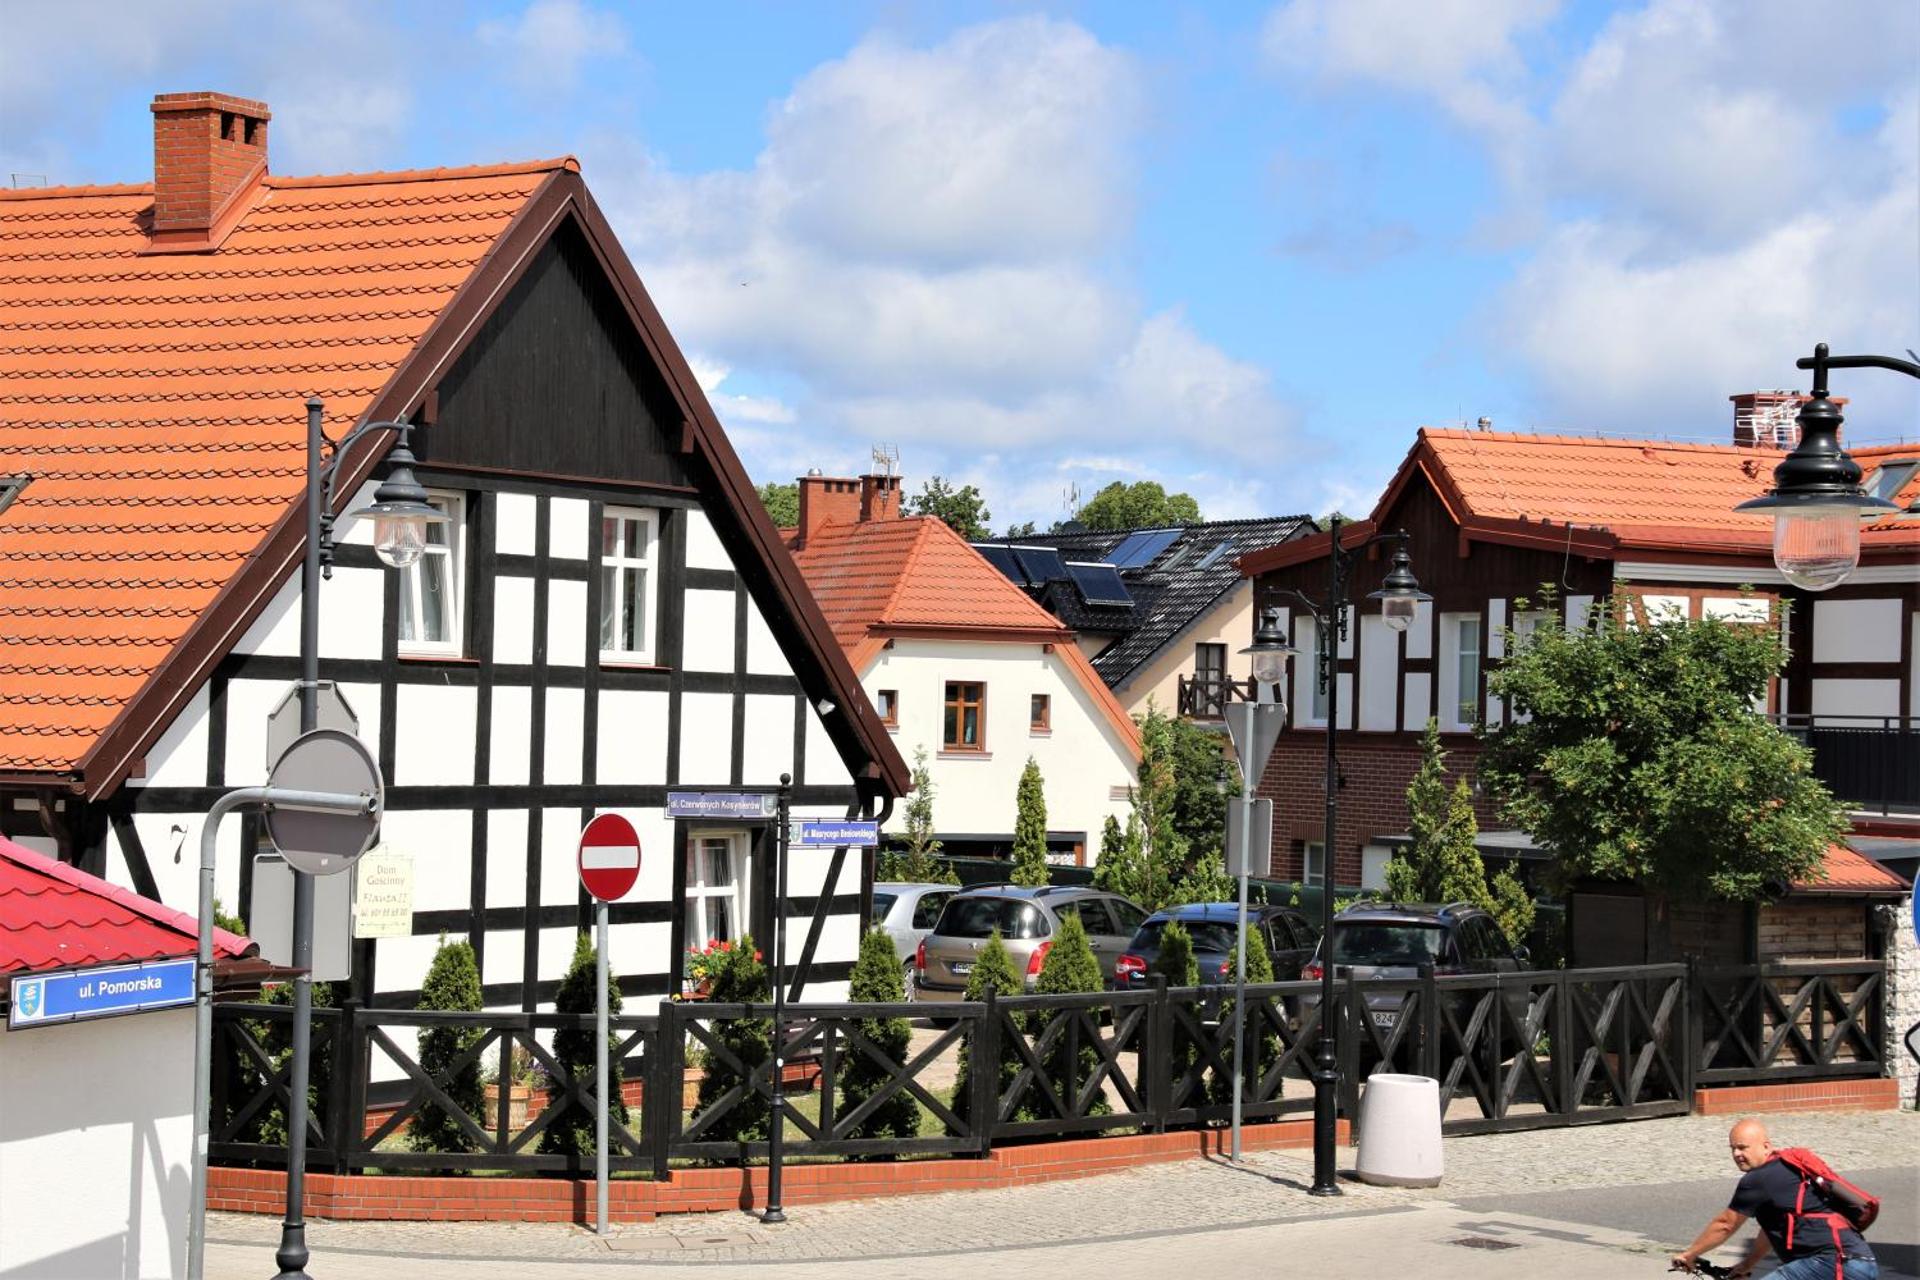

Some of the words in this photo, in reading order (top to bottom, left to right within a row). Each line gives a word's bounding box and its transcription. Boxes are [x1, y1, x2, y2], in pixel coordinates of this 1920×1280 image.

[680, 799, 719, 811] Czerwonych
[170, 824, 188, 864] 7
[377, 864, 397, 875] Dom
[79, 985, 95, 998] ul.
[99, 975, 163, 996] Pomorska
